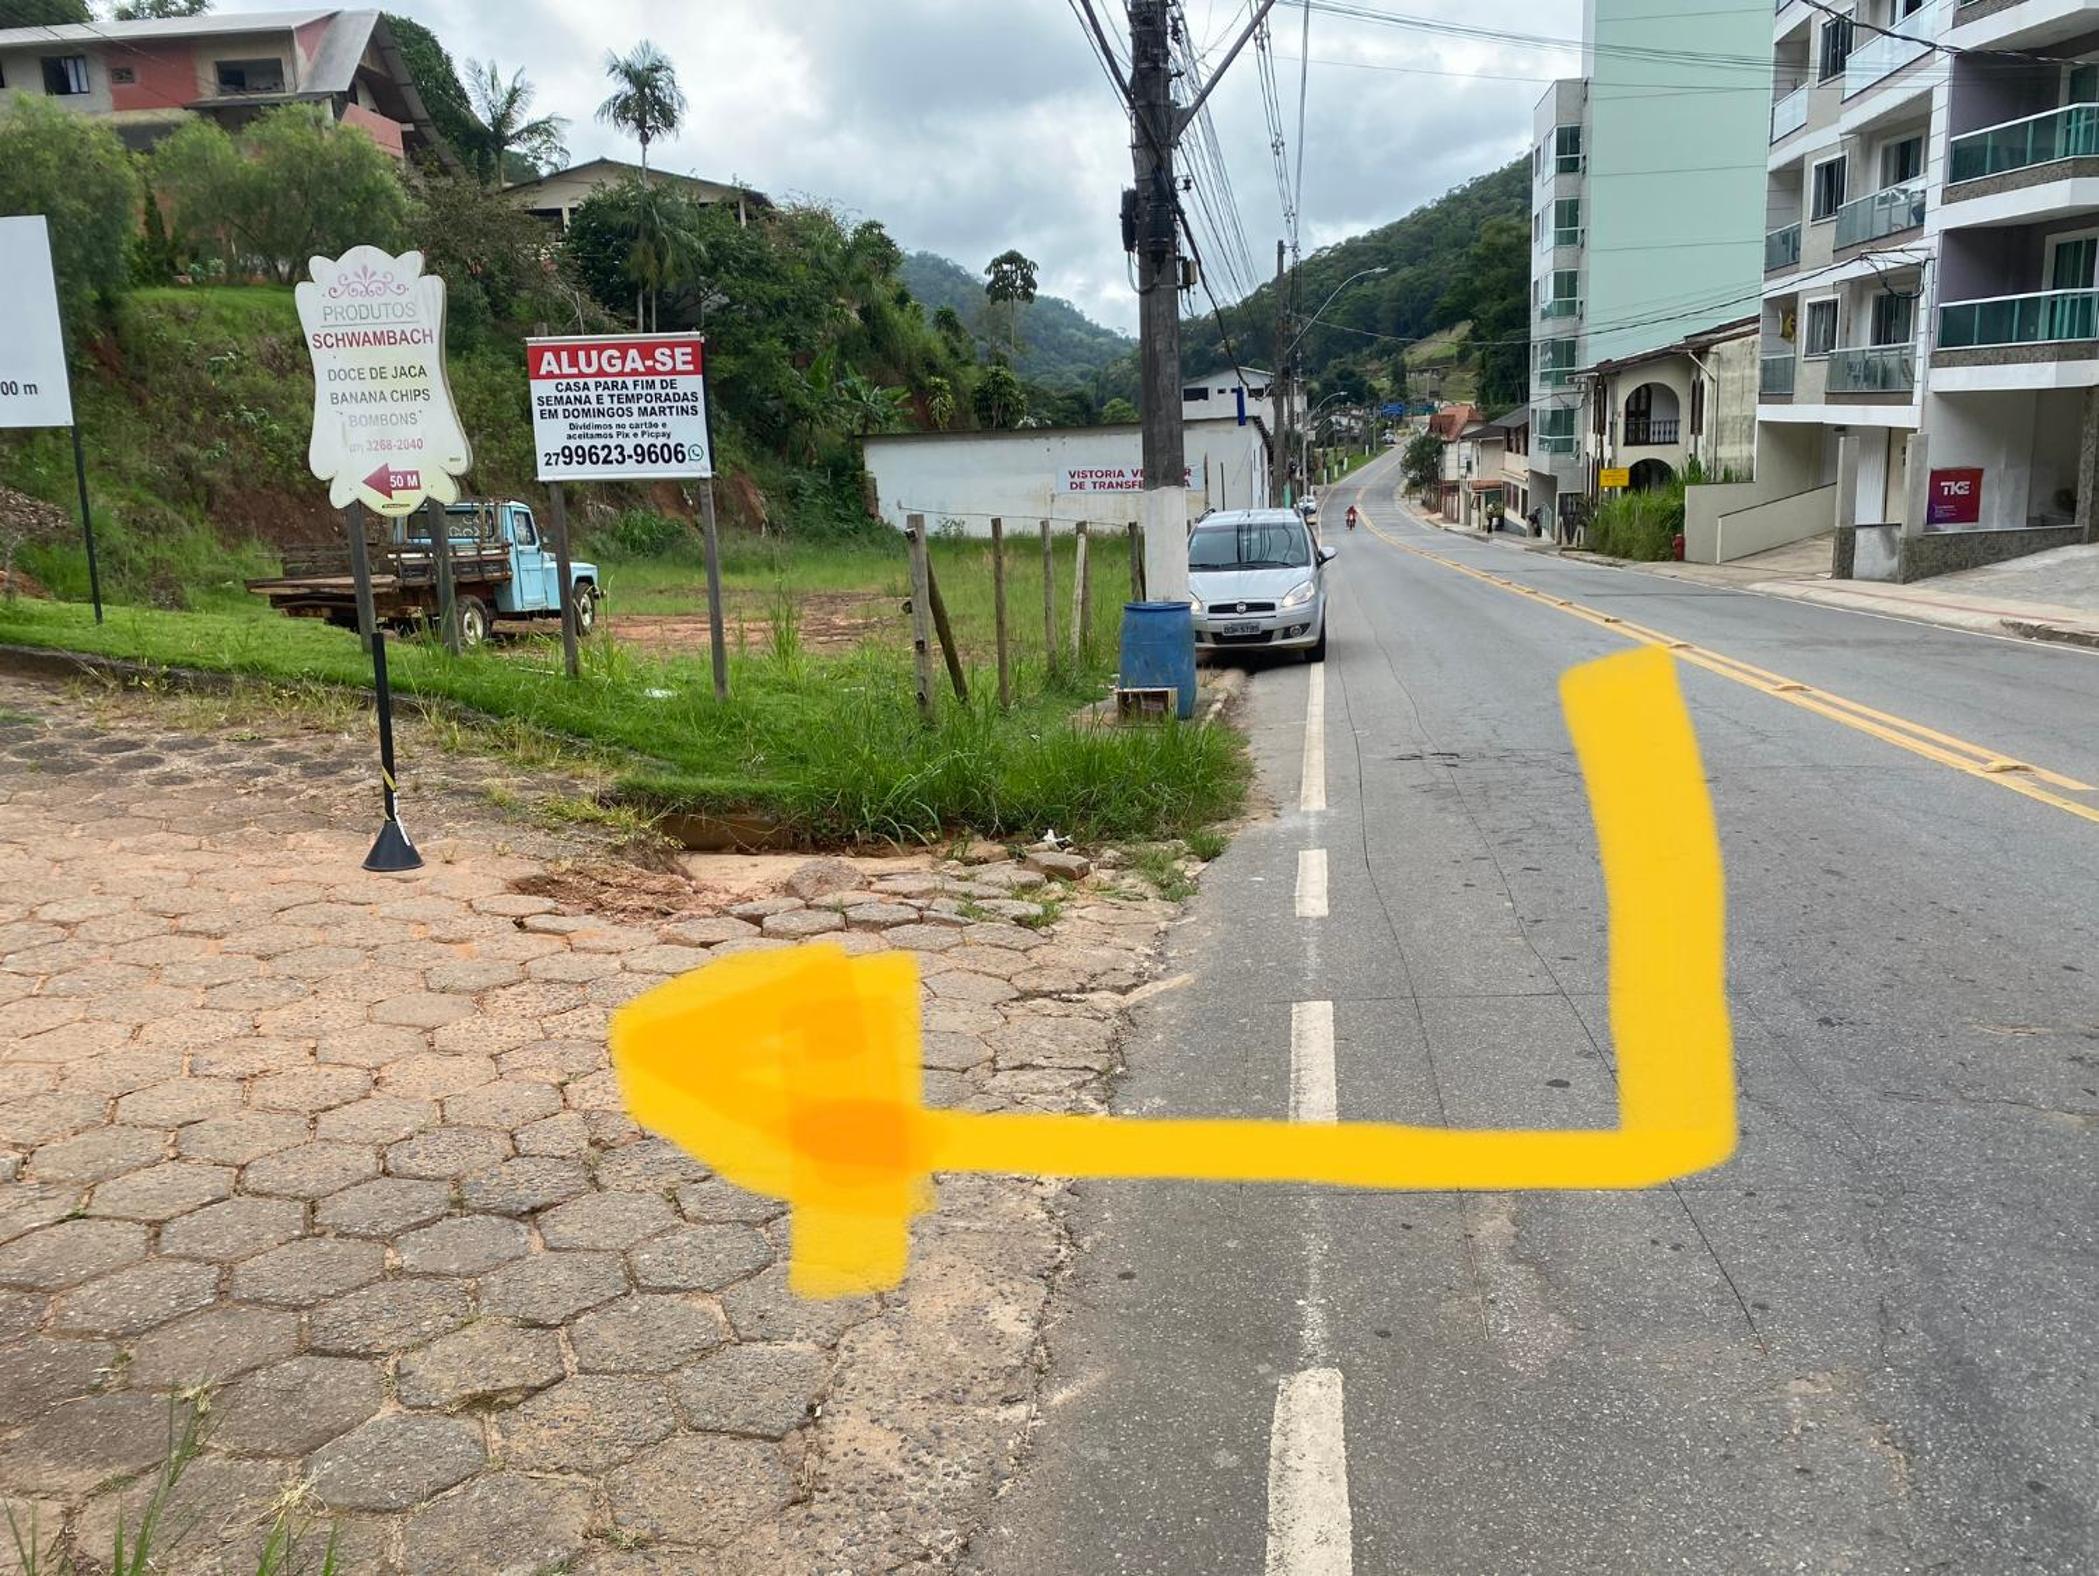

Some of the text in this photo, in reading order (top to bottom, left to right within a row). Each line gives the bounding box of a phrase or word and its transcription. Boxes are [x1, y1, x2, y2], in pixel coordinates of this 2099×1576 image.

[323, 302, 417, 322] PRODUTOS
[312, 328, 434, 349] SCHWAMBACH
[539, 346, 695, 376] ALUGA-SE
[328, 365, 428, 382] DOCE DE JACA
[23, 384, 38, 395] m
[555, 378, 678, 393] CASA PARA FIM DE
[330, 388, 431, 405] BANANA CHIPS
[537, 391, 699, 407] SEMANA E TEMPORADAS
[350, 412, 418, 428] BOMBONS
[539, 405, 699, 420] EM DOMINGOS MARTINS
[568, 421, 613, 431] Dividimos
[615, 423, 627, 431] no
[629, 421, 659, 430] cartão
[566, 431, 614, 441] aceitamos
[616, 430, 630, 439] Pix
[641, 430, 672, 441] Picpay
[390, 474, 418, 488] 50 M
[1068, 468, 1126, 480] VISTORIA
[1070, 480, 1086, 491] DE
[1940, 480, 1971, 496] TKE
